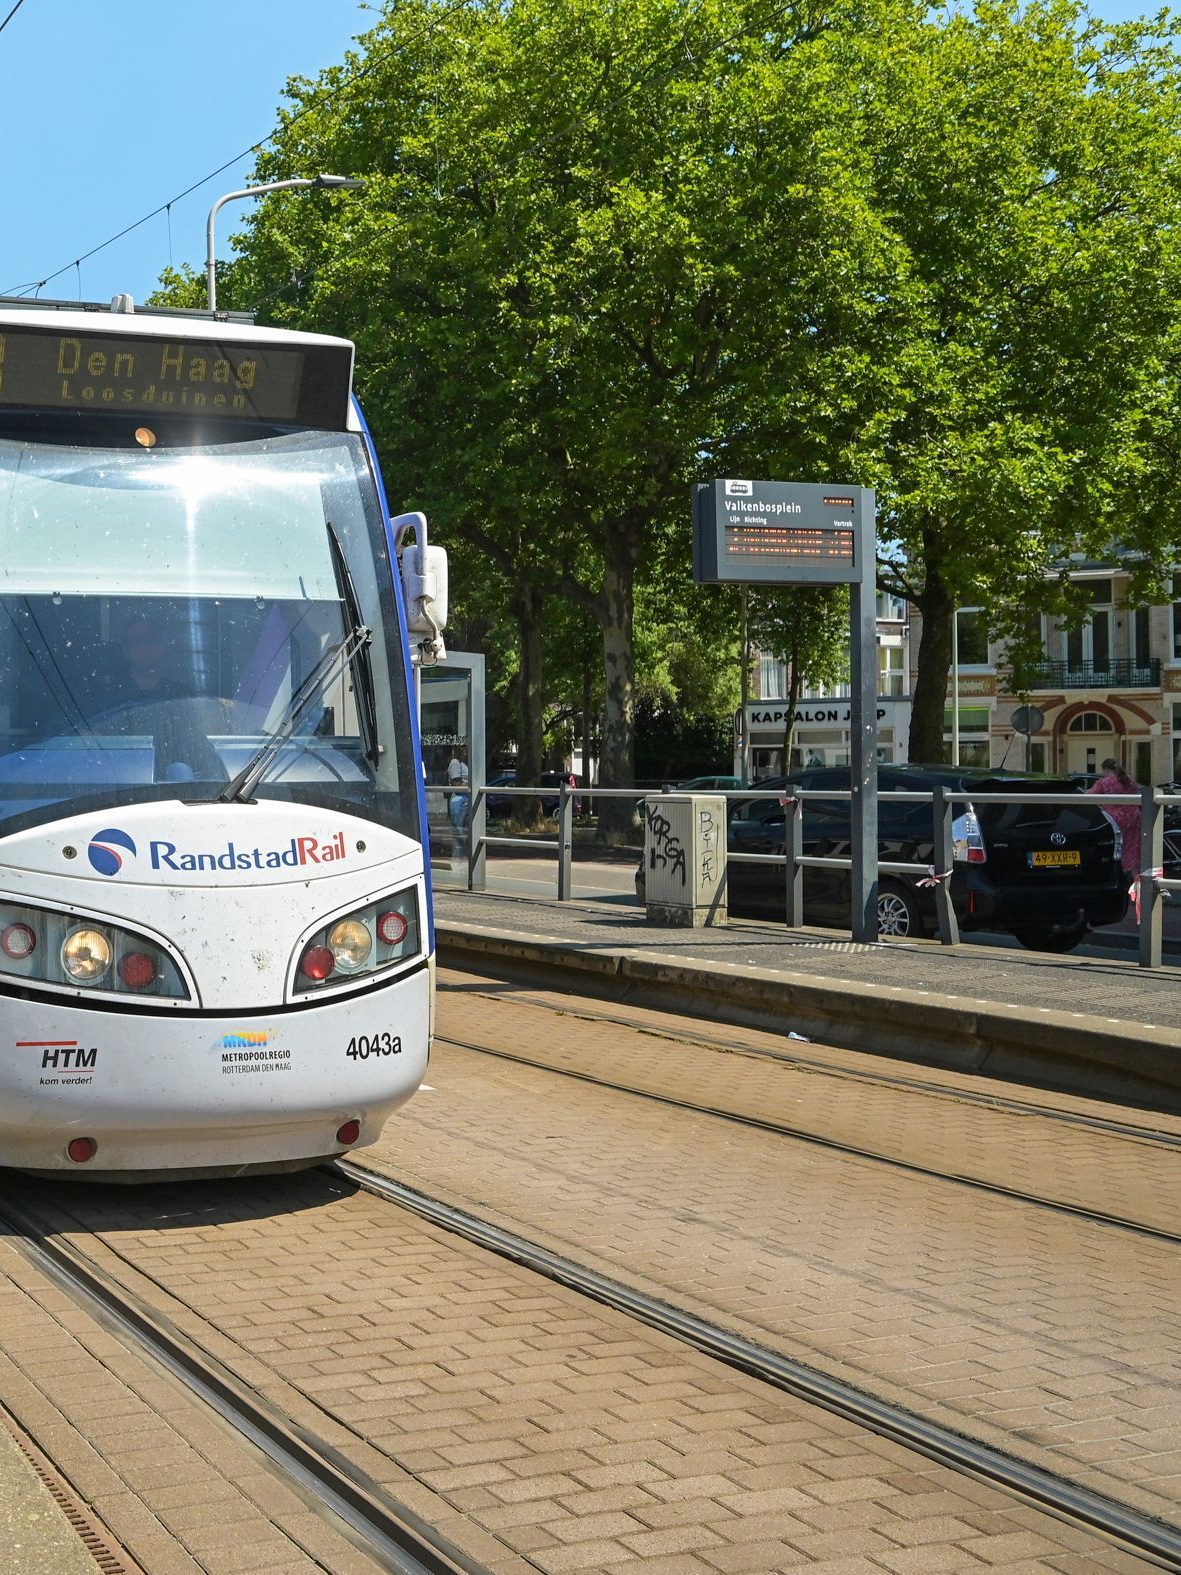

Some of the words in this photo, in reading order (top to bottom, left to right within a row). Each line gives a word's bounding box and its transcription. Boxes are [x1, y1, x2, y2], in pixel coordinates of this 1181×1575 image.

[57, 337, 135, 377] Den
[160, 344, 257, 389] Haag
[61, 380, 246, 409] Loosduinen
[725, 501, 802, 515] Valkenbosplein
[729, 515, 740, 523] Lijn
[744, 516, 767, 525] Richting
[843, 709, 886, 721] JP
[150, 832, 346, 871] RandstadRail
[223, 1031, 268, 1048] MRDH
[346, 1032, 402, 1061] 4043a
[41, 1048, 98, 1069] HTM
[221, 1050, 291, 1063] METROPOOLREGIO
[222, 1065, 261, 1075] ROTTERDAM
[262, 1063, 274, 1073] DEN
[40, 1077, 59, 1086] kom
[61, 1076, 93, 1086] verder!
